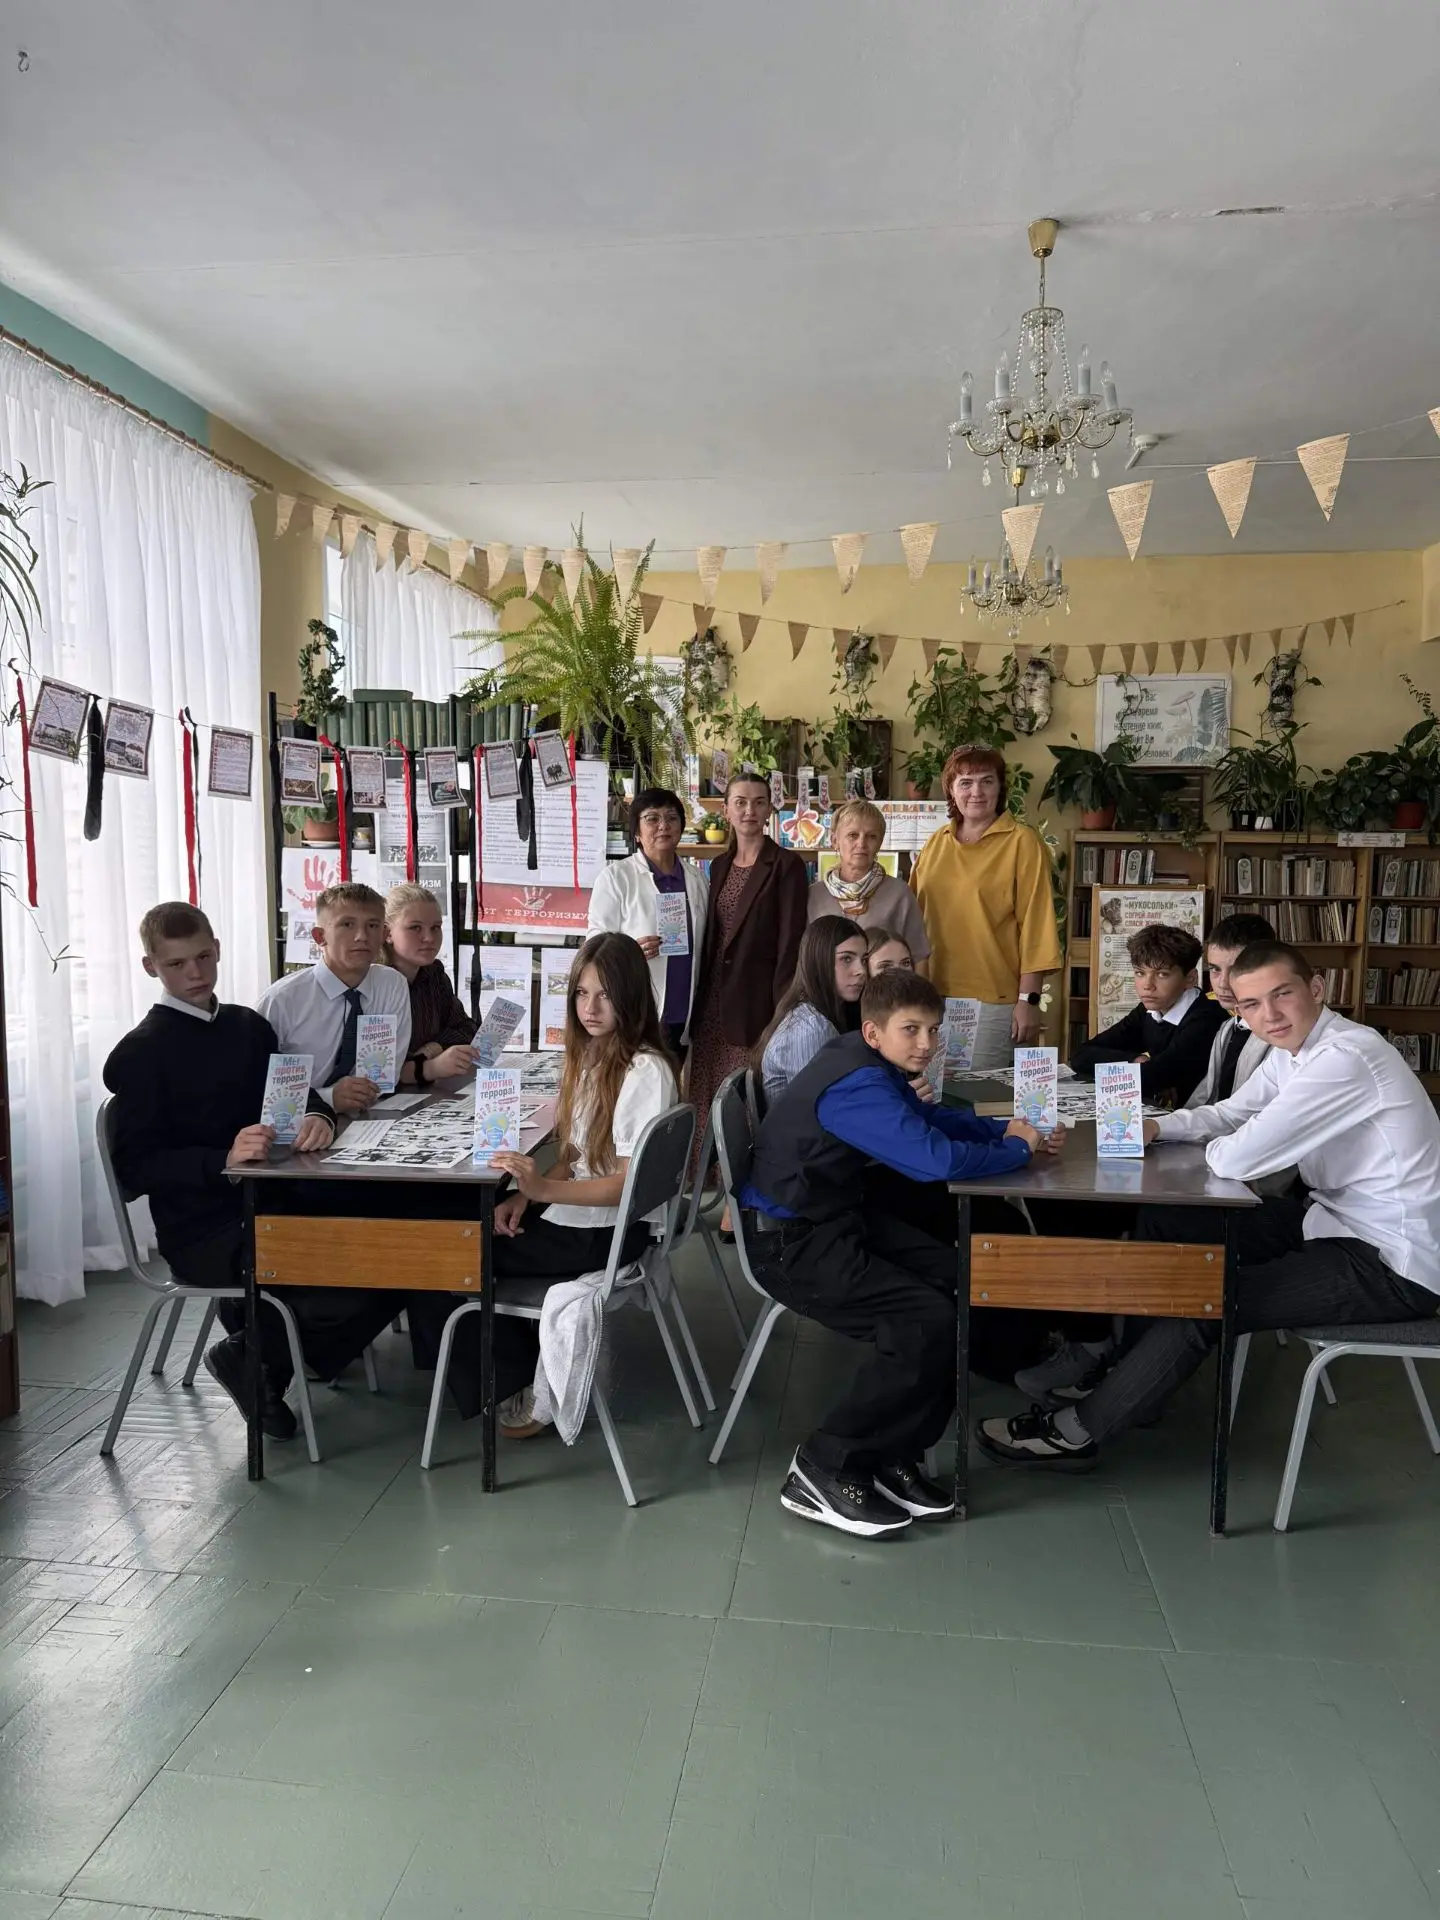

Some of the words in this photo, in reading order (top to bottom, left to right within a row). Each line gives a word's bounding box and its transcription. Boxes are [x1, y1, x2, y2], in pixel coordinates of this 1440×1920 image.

[956, 1000, 969, 1009] Мы
[950, 1007, 975, 1015] против
[368, 1016, 384, 1025] Мы
[948, 1013, 976, 1023] террора!
[363, 1023, 390, 1034] против
[361, 1029, 392, 1041] террора!
[1027, 1049, 1043, 1060] Мы
[282, 1055, 300, 1066] Мы
[1021, 1057, 1051, 1070] против
[274, 1064, 306, 1076] против
[1020, 1063, 1053, 1078] террора!
[1108, 1064, 1125, 1075] Мы
[272, 1072, 307, 1085] террора!
[488, 1070, 505, 1081] Мы
[1101, 1073, 1133, 1085] против
[482, 1078, 513, 1092] против
[1100, 1079, 1136, 1095] террора!
[480, 1085, 515, 1100] террора!
